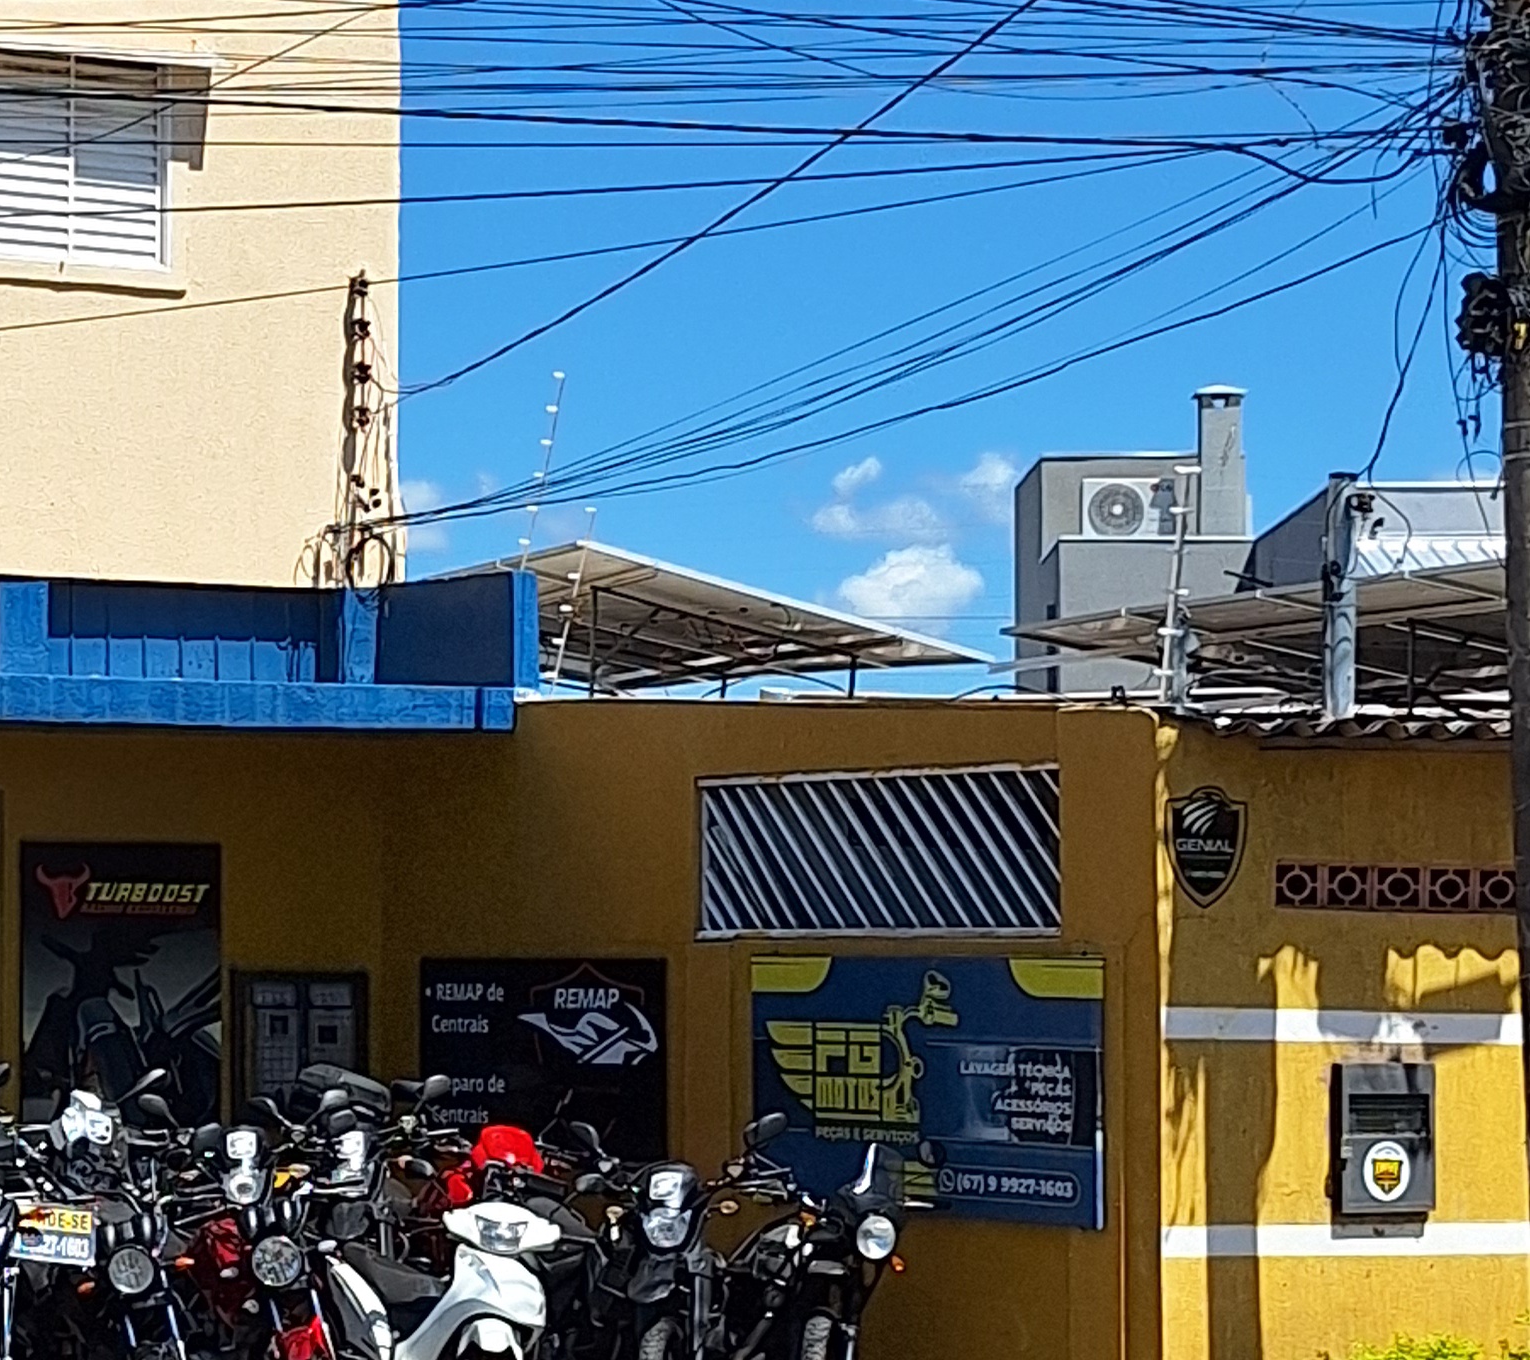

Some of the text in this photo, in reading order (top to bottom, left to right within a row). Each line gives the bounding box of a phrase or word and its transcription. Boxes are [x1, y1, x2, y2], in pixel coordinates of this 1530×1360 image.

[1176, 838, 1234, 853] GENIAL
[85, 882, 210, 903] TURBOOST
[436, 983, 505, 1002] REMAP de
[554, 988, 620, 1009] REMAP
[432, 1014, 489, 1033] Centrais
[816, 1030, 881, 1074] FG
[487, 1073, 506, 1094] de
[816, 1076, 881, 1111] MOTOS
[432, 1104, 489, 1124] Centrais
[957, 1172, 1074, 1198] (67) 9 9927-1603
